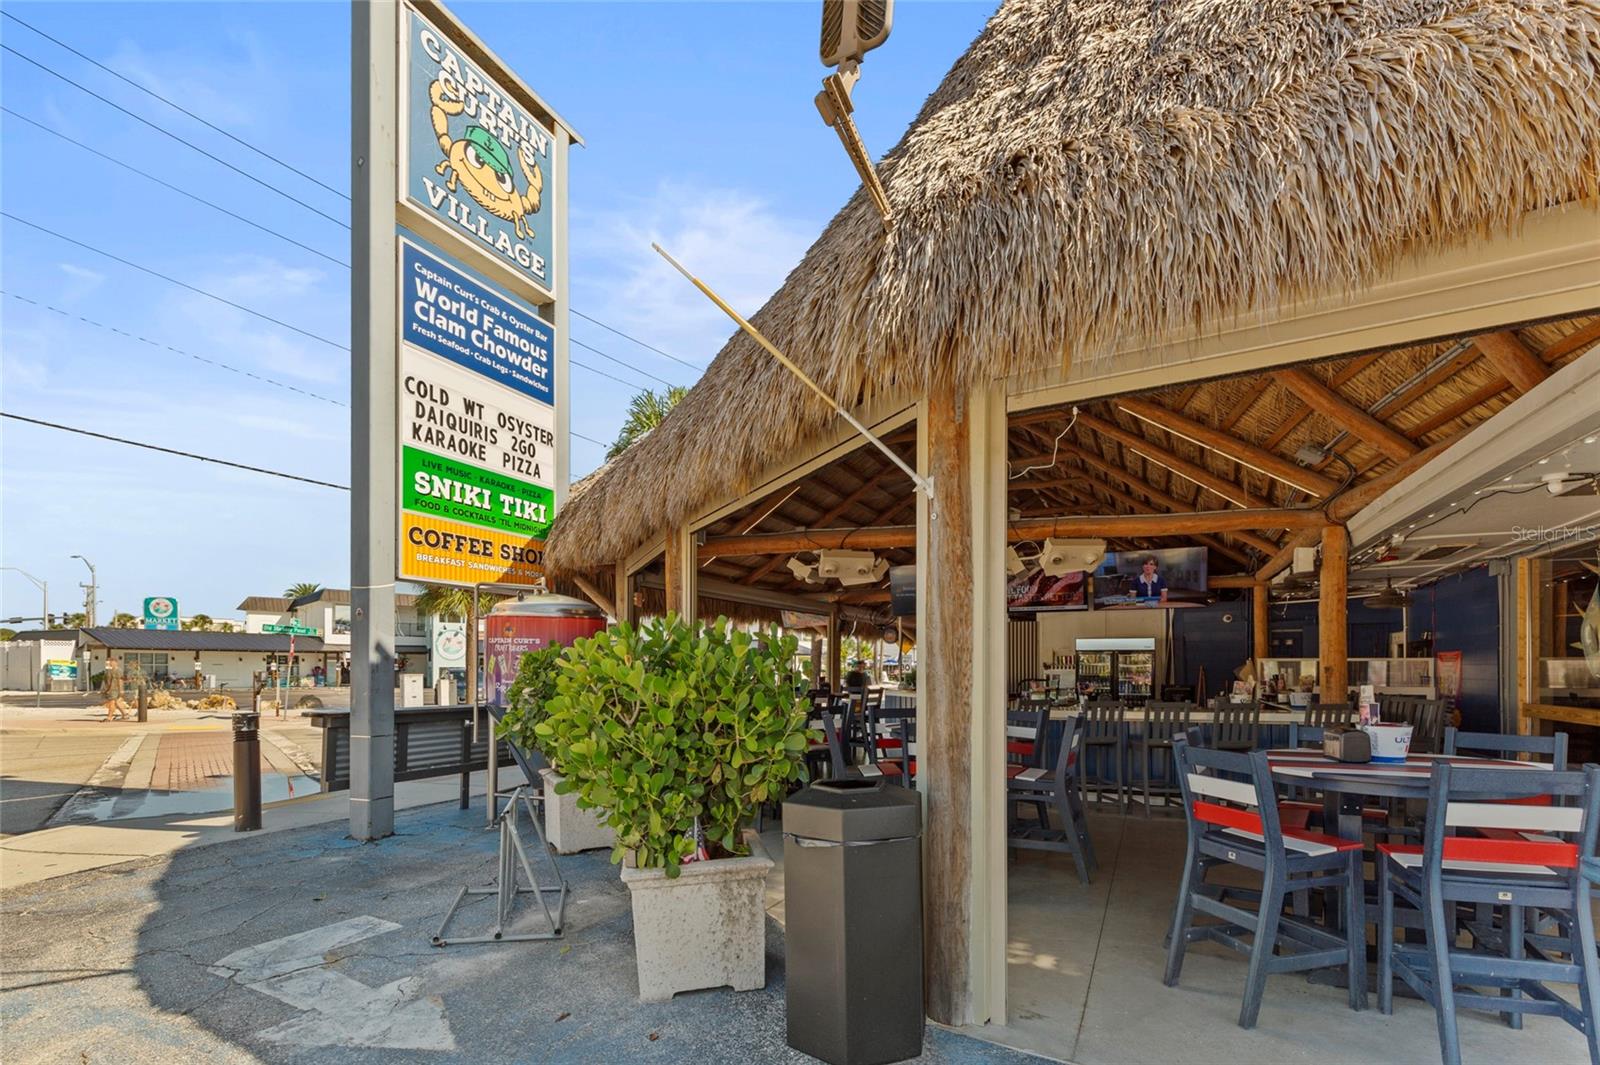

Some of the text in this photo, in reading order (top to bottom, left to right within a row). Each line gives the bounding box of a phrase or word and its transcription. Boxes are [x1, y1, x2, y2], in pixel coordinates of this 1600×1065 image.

[420, 29, 548, 158] CAPTAIN
[438, 70, 536, 167] CURT'S
[422, 176, 546, 281] VILLAGE
[414, 262, 548, 342] Captain Curt's Crab & Oyster Bar
[415, 277, 548, 362] World Famous
[412, 322, 549, 393] Fresh Seafood Crab Legs Sandwiches
[414, 301, 548, 379] Clam Chowder
[404, 376, 554, 448] COLD WT OSYSTER
[415, 400, 536, 458] DAIQUIRIS 2GO
[412, 422, 541, 479] KARAOKE PIZZA
[422, 458, 542, 499] LIVE MUSIC KARAOKE PIZZA
[414, 471, 547, 524] SNIKI TIKI
[414, 498, 441, 511] FOOD
[443, 504, 449, 513] &
[452, 507, 497, 525] COCKTAILS
[408, 526, 493, 557] COFFEE
[416, 553, 465, 567] BREAKFAST
[468, 562, 516, 575] SANDWICHES
